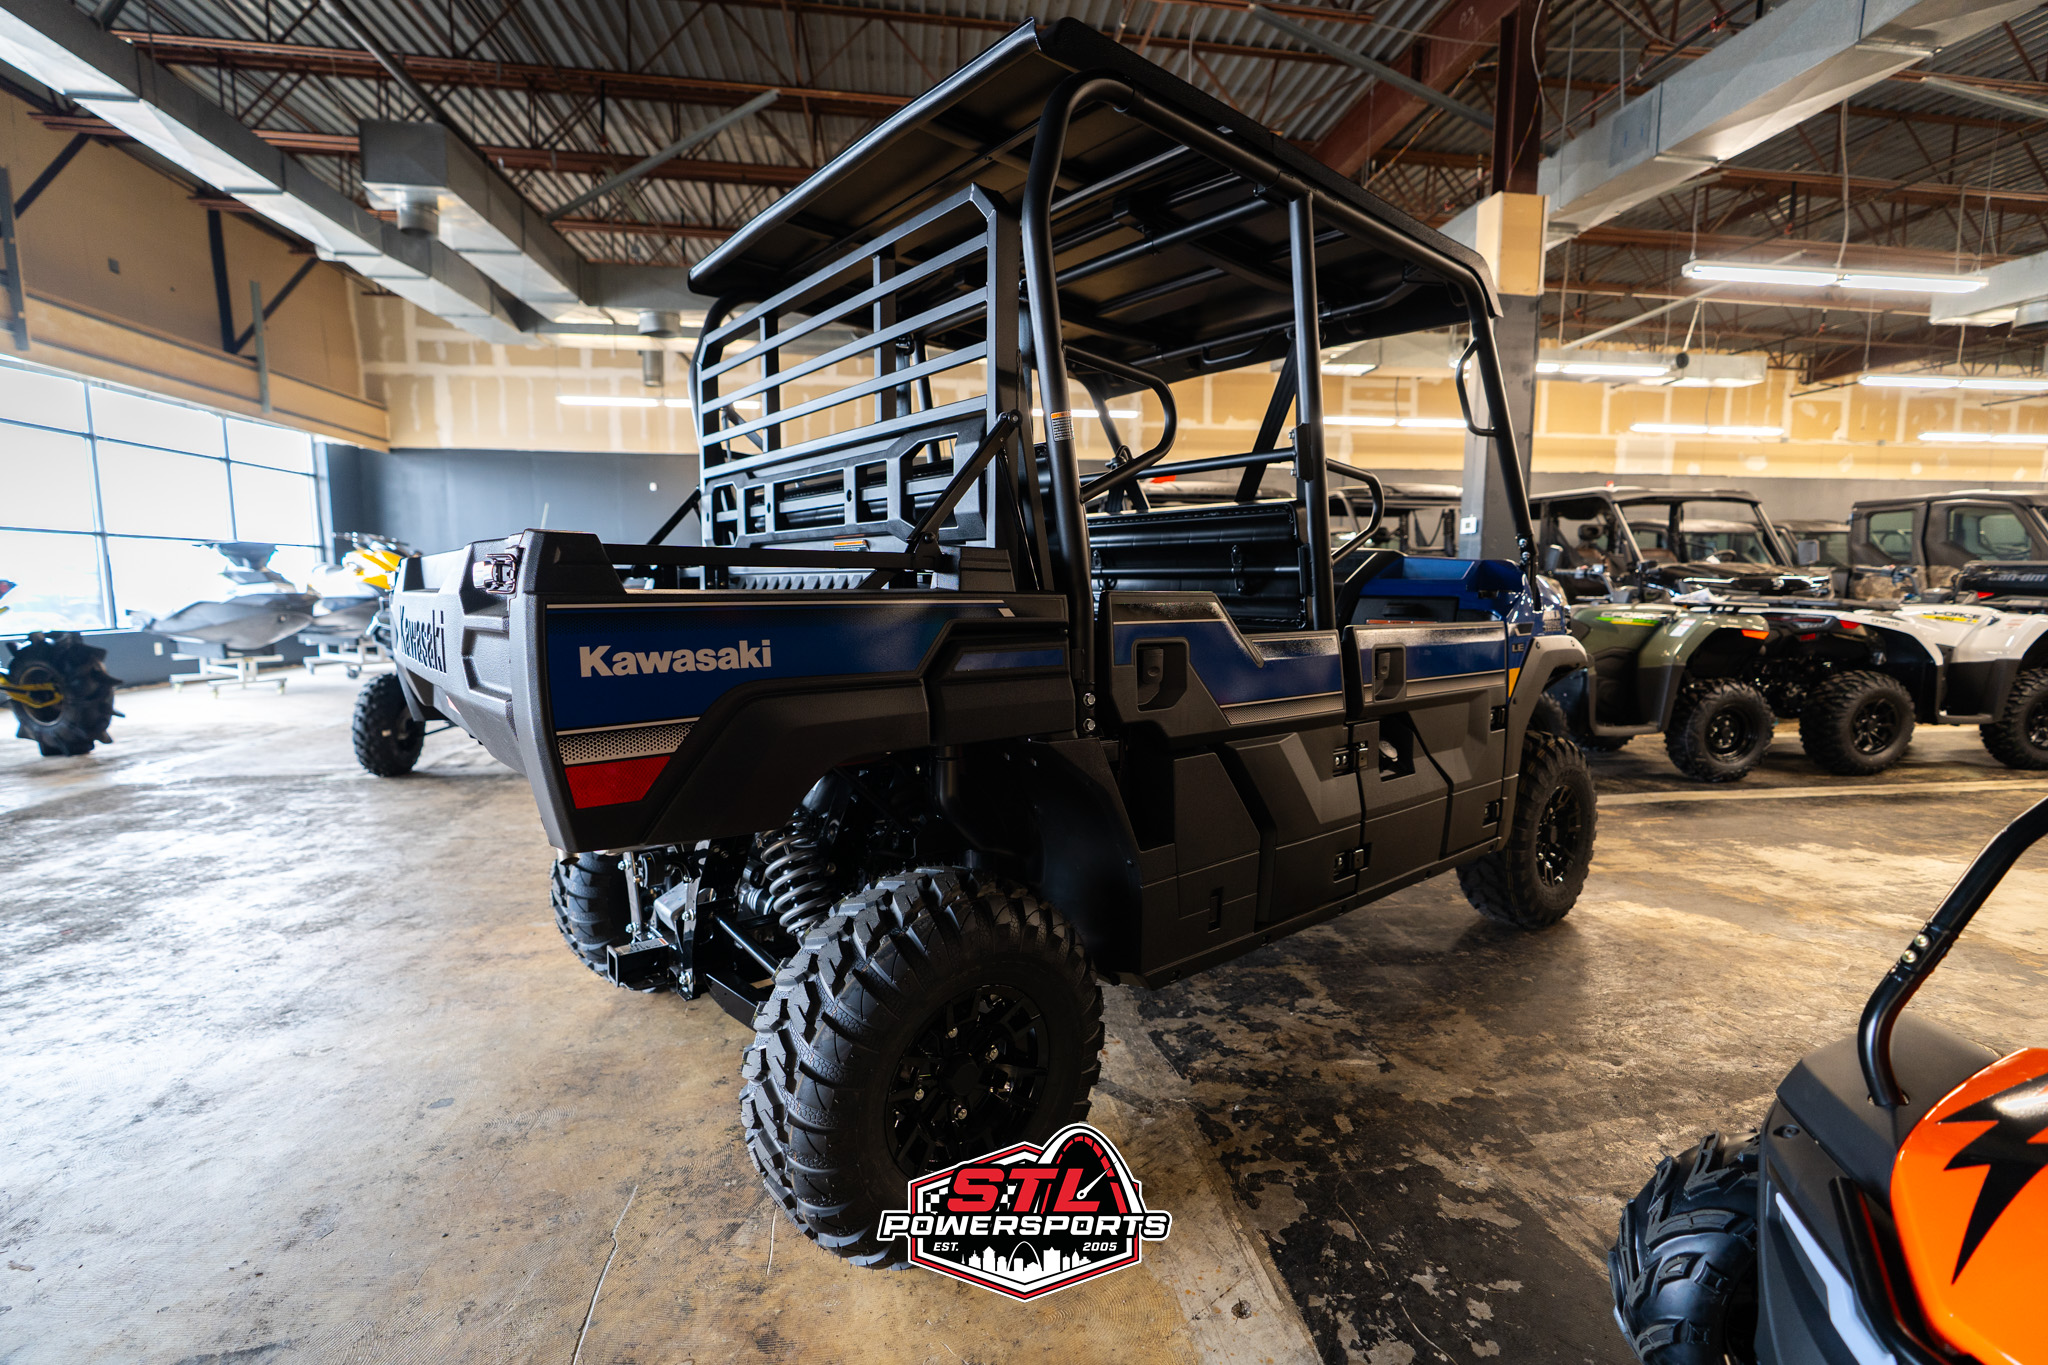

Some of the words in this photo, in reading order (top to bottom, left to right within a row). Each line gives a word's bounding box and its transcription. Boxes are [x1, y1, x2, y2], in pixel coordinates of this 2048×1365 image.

[399, 605, 447, 674] Kawasaki
[579, 639, 772, 678] Kawasaki
[1511, 643, 1524, 653] LE
